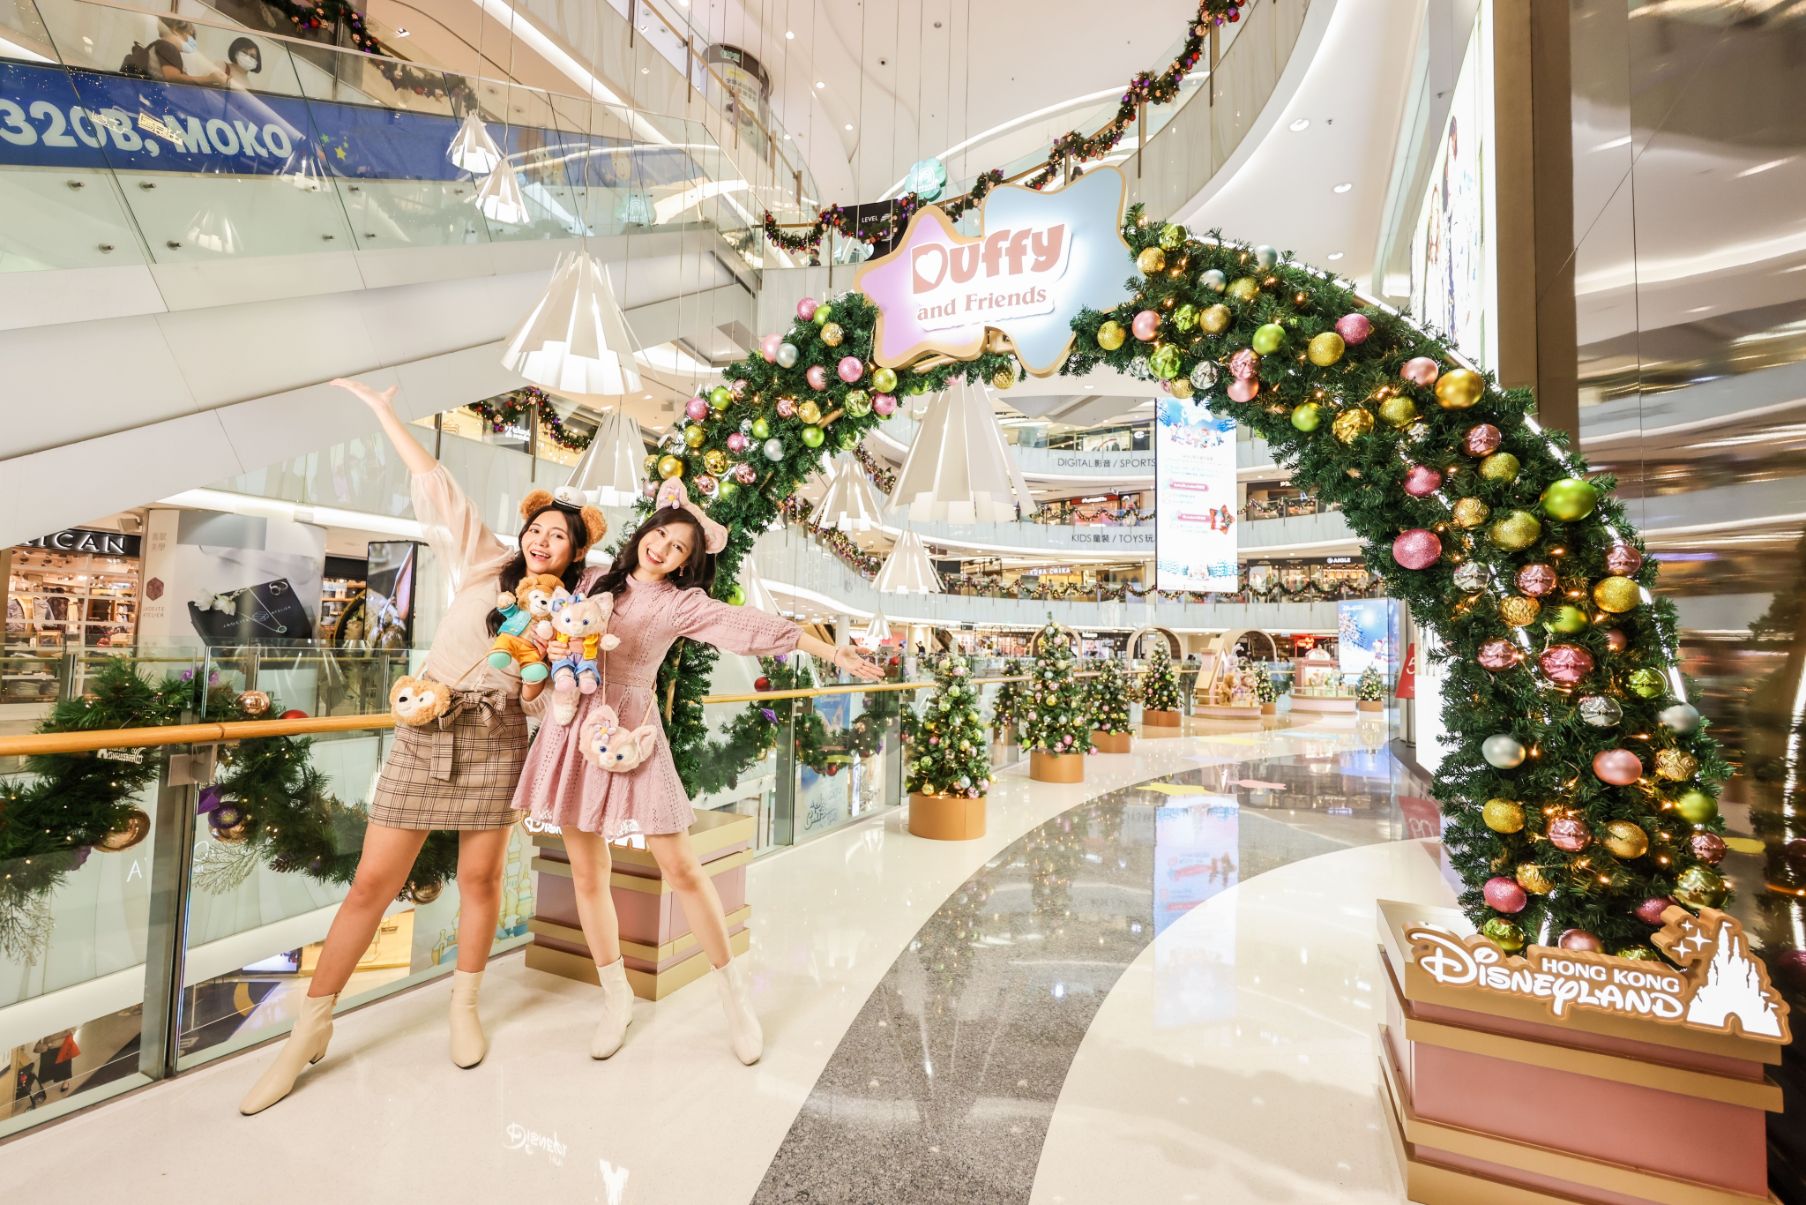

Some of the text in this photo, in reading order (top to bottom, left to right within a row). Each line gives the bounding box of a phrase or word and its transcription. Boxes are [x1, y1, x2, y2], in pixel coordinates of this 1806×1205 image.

[163, 115, 293, 159] MOKO
[861, 215, 878, 223] LEVEL
[911, 223, 1065, 295] Duffy
[917, 286, 1047, 321] and Friends
[1057, 458, 1094, 468] DIGITAL
[1071, 534, 1092, 543] KIDS
[1119, 533, 1144, 543] TOYS
[1542, 957, 1680, 993] HONG KONG
